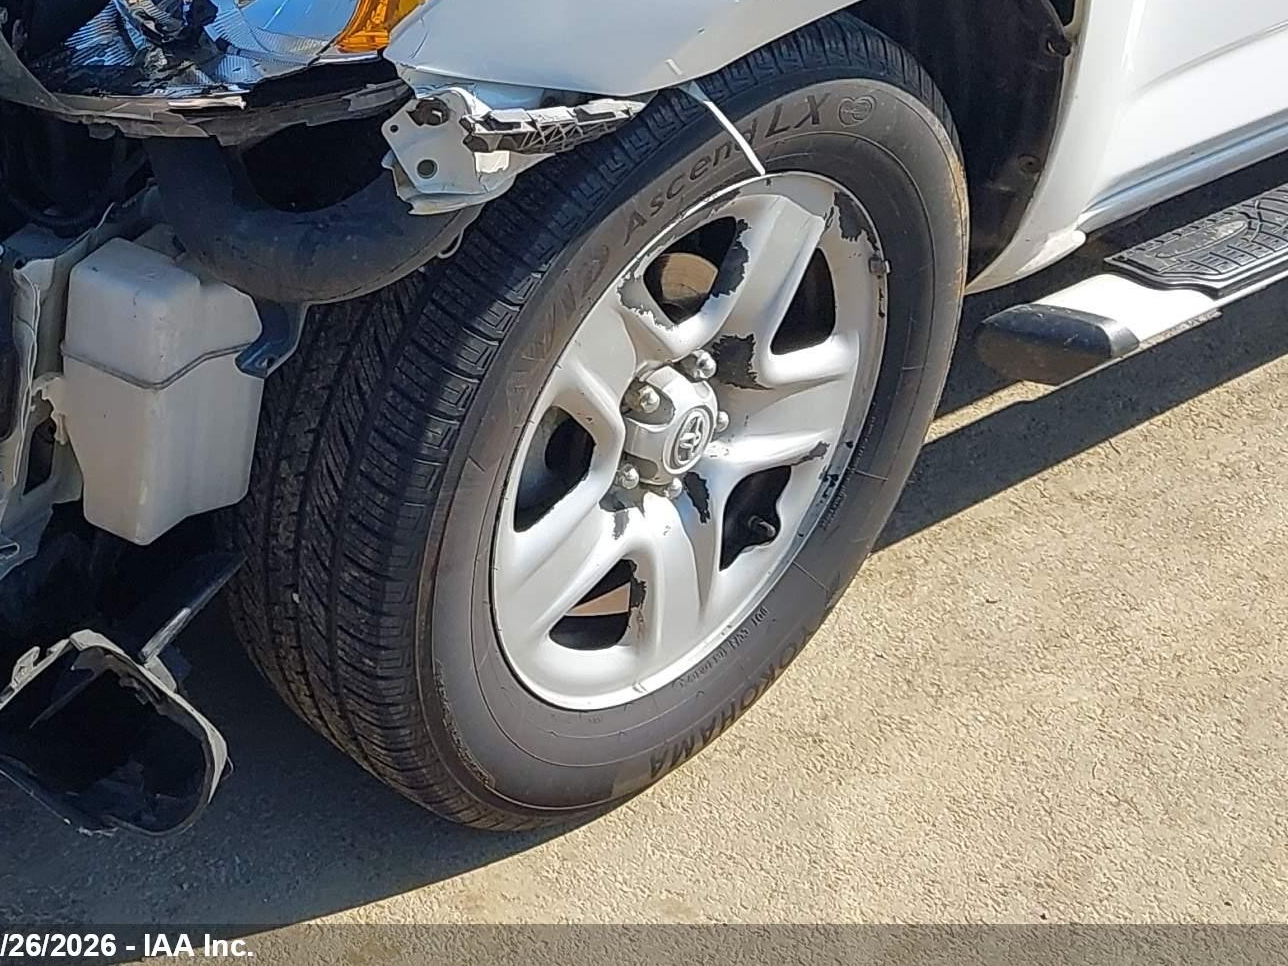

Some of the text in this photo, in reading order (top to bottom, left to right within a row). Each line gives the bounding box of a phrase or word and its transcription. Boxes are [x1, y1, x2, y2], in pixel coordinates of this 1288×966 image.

[623, 118, 758, 246] Ascend
[765, 93, 831, 138] LX
[649, 626, 815, 781] YOKOHAMA
